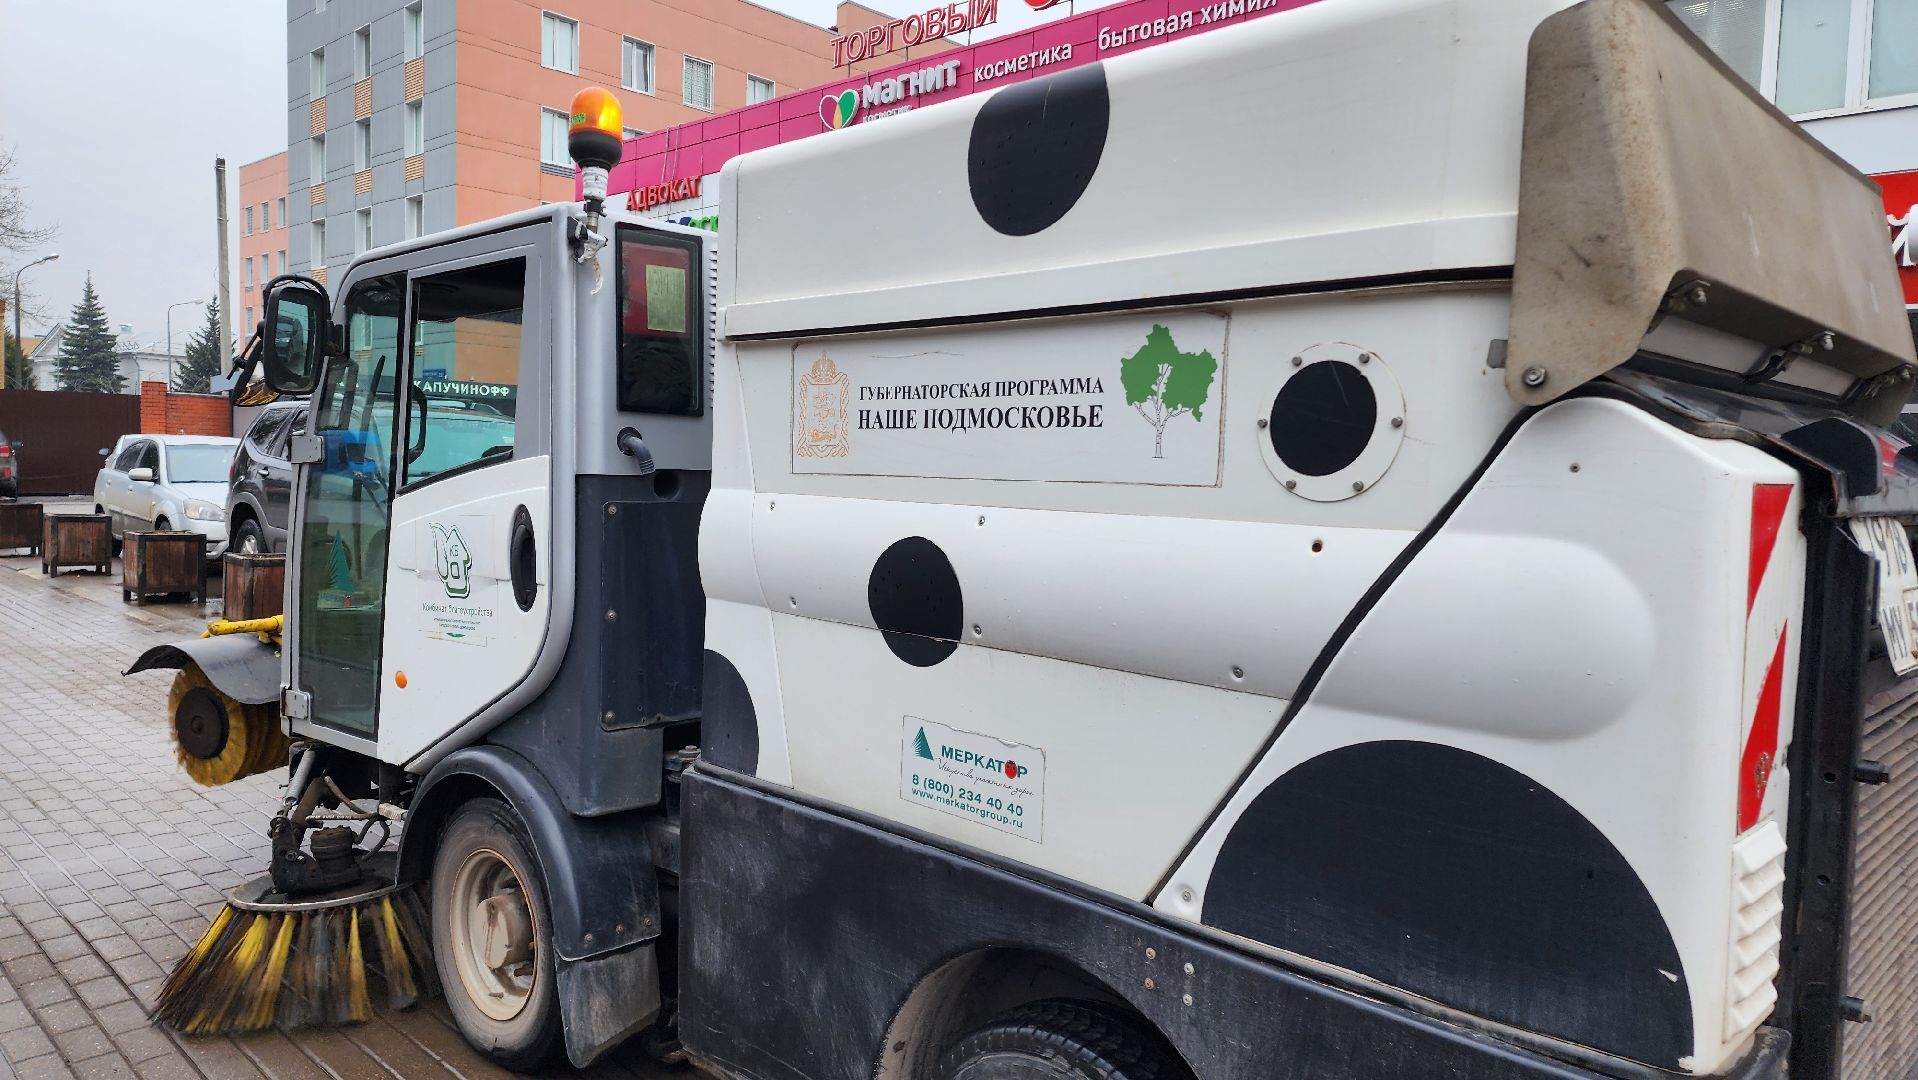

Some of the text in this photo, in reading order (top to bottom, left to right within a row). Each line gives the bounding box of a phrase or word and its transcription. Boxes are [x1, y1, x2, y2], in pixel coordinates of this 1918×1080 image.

[974, 42, 1072, 82] косметика
[1098, 11, 1193, 50] бытовая
[626, 176, 702, 211] АДВОКАТ
[859, 377, 1104, 400] ГУБЕРНАТОРСКАЯ ПРОГРАММА
[858, 405, 1104, 434] НАШЕ ПОДМОСКОВЬЕ
[941, 745, 1028, 779] МЕРКАТОР
[911, 787, 1023, 828] www.merkatorgroup.ru
[912, 774, 1023, 817] 8 (800) 234 40 40
